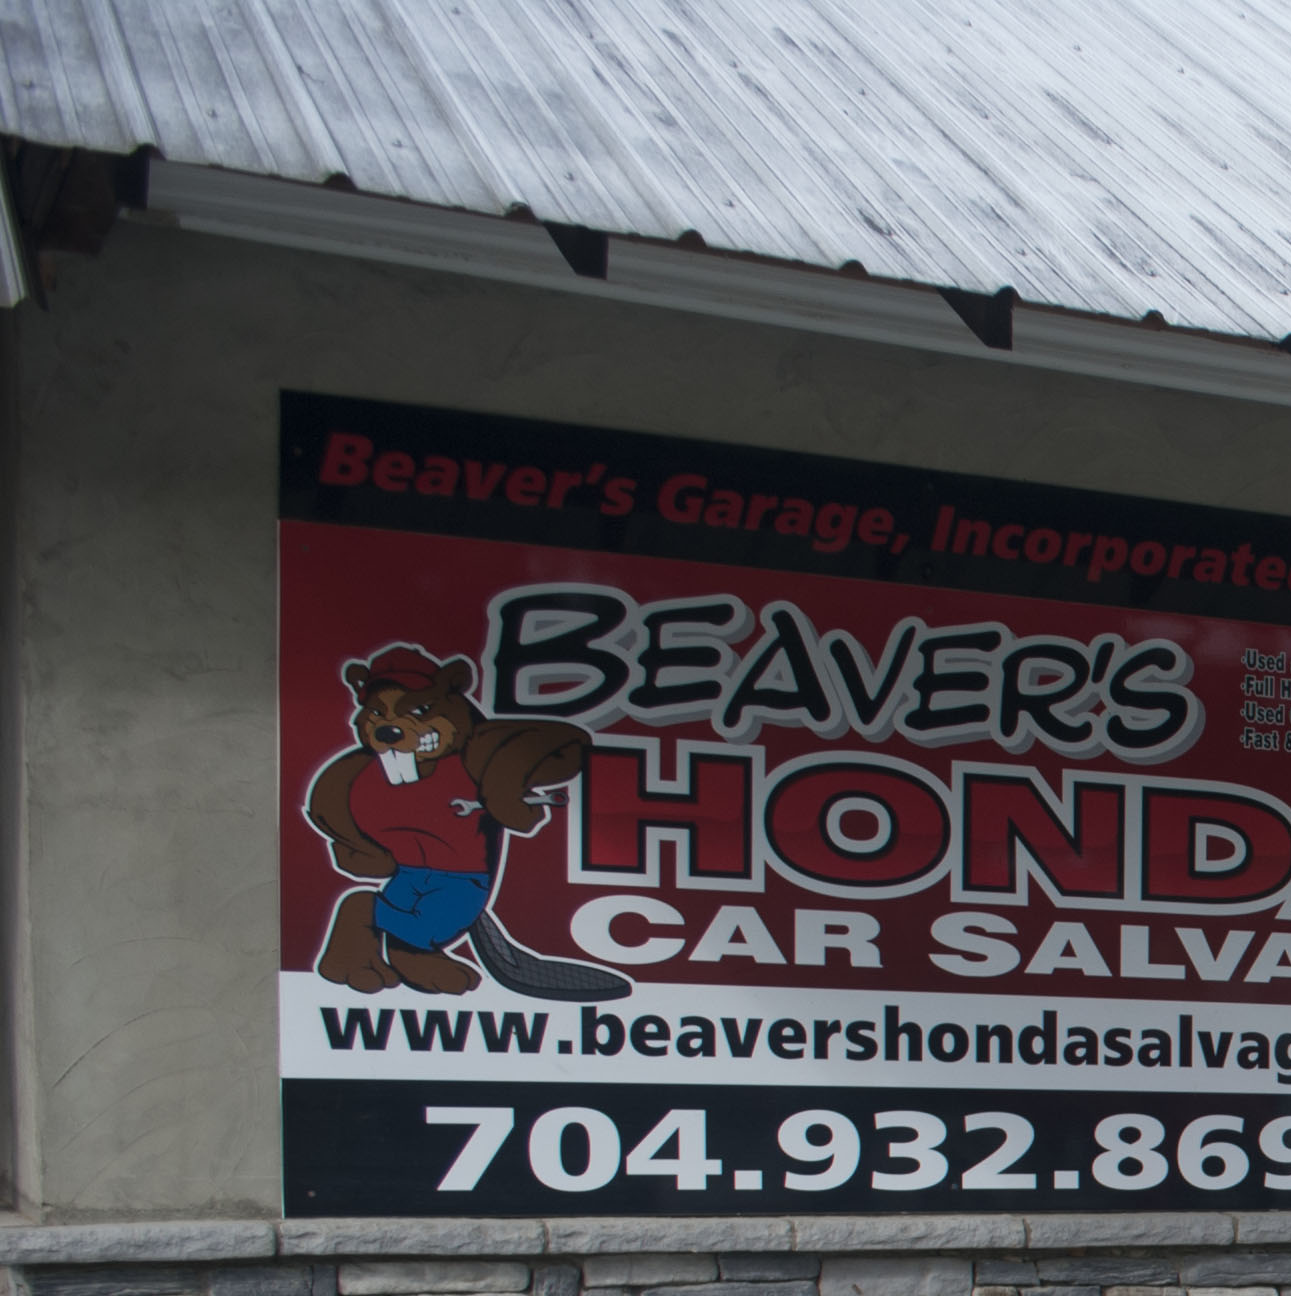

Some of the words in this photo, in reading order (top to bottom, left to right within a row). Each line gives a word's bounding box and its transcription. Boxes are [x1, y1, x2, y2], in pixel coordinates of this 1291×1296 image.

[319, 432, 638, 516] Beaver's
[657, 474, 910, 554] Garage,
[1244, 648, 1286, 673] Used
[486, 583, 1205, 764] BEAVER'S
[1244, 674, 1275, 698] Full
[1244, 702, 1285, 725] Used
[1243, 728, 1279, 751] Fast
[570, 894, 883, 968] CAR
